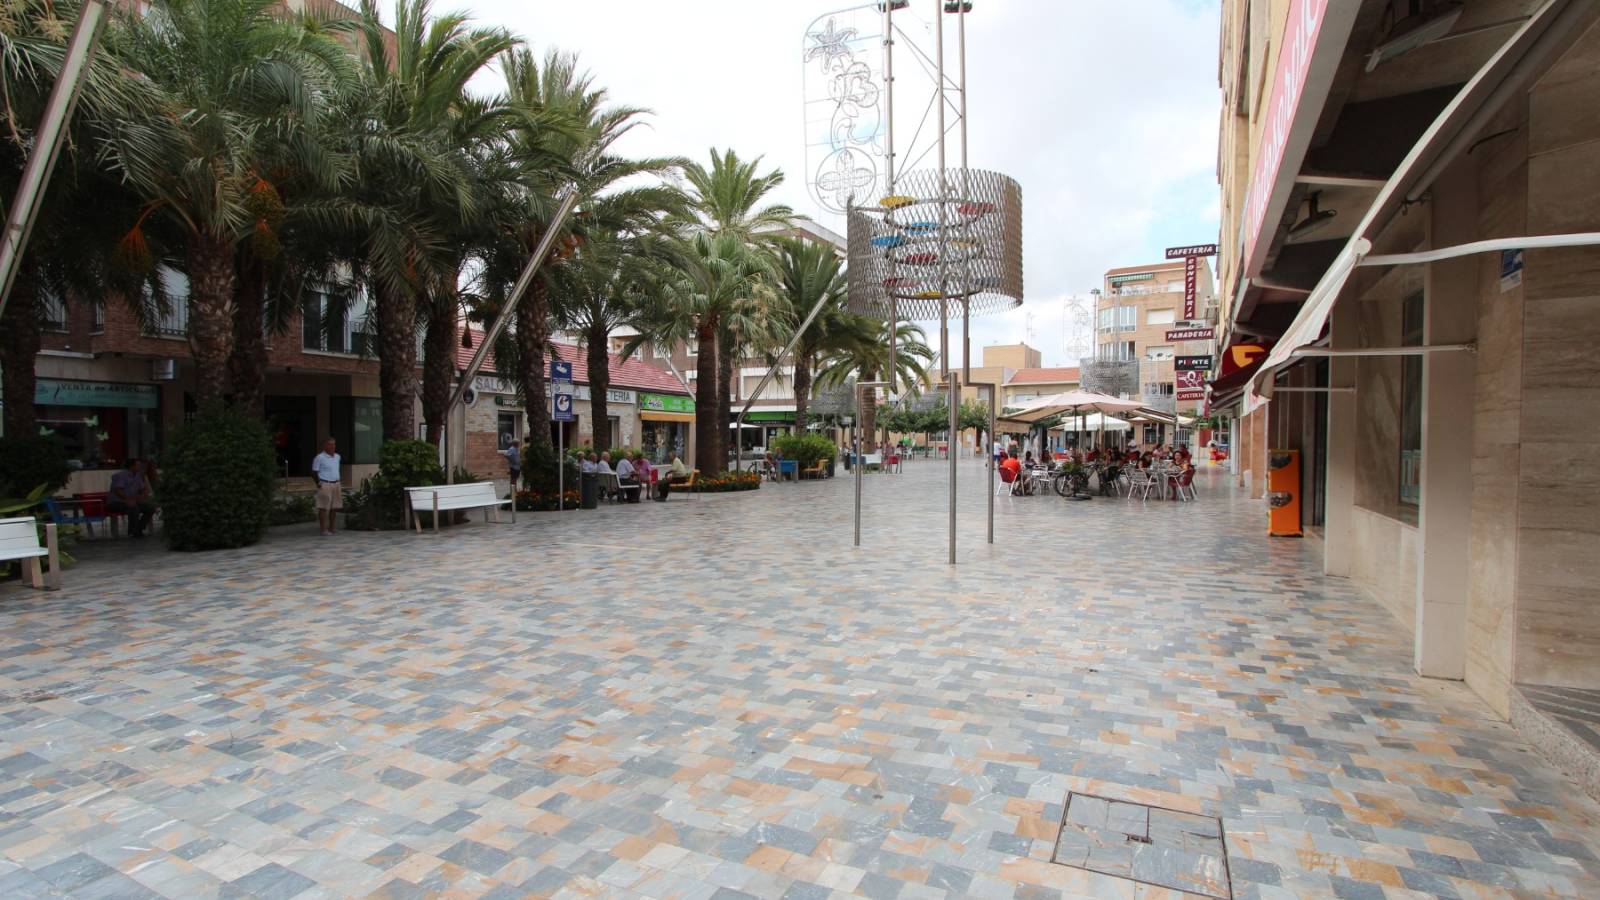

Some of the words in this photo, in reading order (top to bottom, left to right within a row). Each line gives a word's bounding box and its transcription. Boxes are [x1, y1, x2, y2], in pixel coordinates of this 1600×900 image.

[1167, 246, 1213, 256] CAFETERIA
[1186, 258, 1196, 318] CONFITERIA
[1167, 330, 1212, 339] PANADERIA
